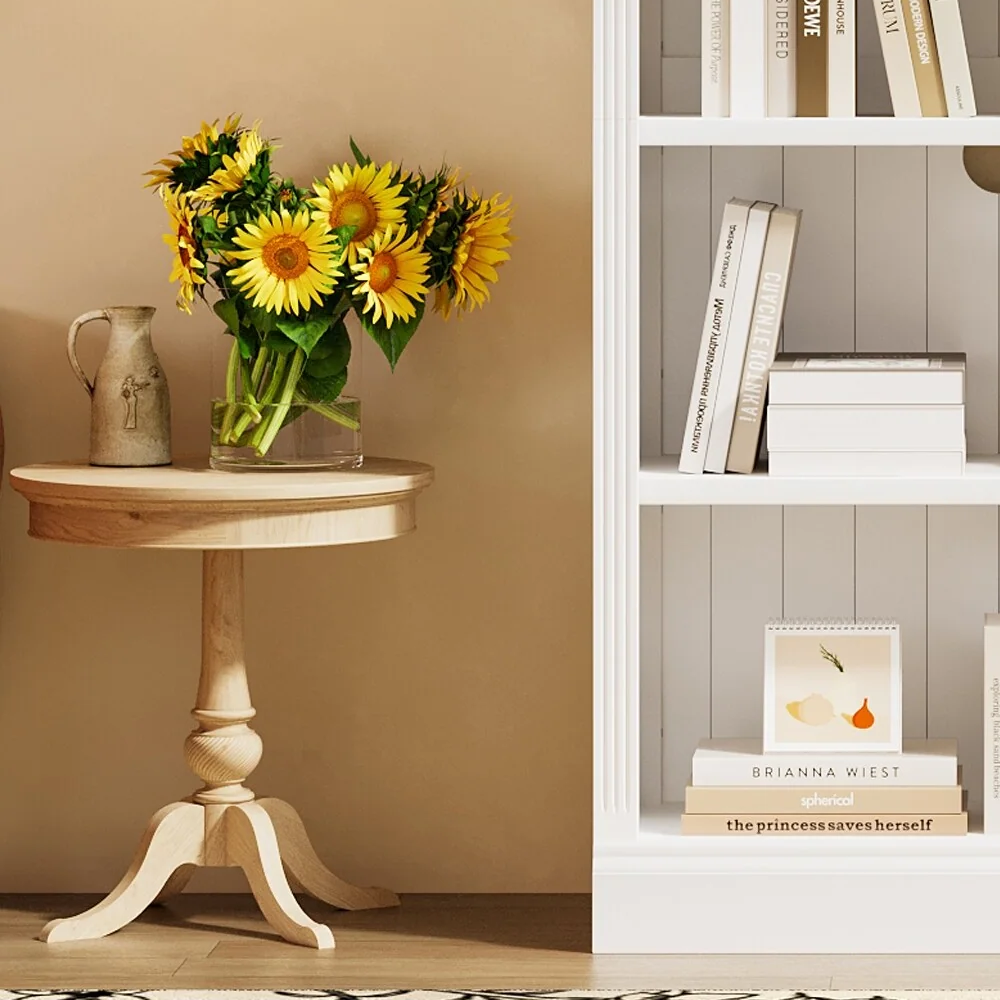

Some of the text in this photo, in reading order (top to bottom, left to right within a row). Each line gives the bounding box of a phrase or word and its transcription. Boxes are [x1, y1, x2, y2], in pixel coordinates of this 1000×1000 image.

[711, 11, 721, 41] POWER
[881, 0, 899, 34] RUM
[711, 42, 721, 53] OF
[915, 33, 930, 64] DESIGN
[991, 678, 1000, 718] exploring
[752, 767, 900, 778] BRIANNA WIEST
[801, 792, 854, 808] spherical
[727, 819, 933, 834] the princess saves herself
